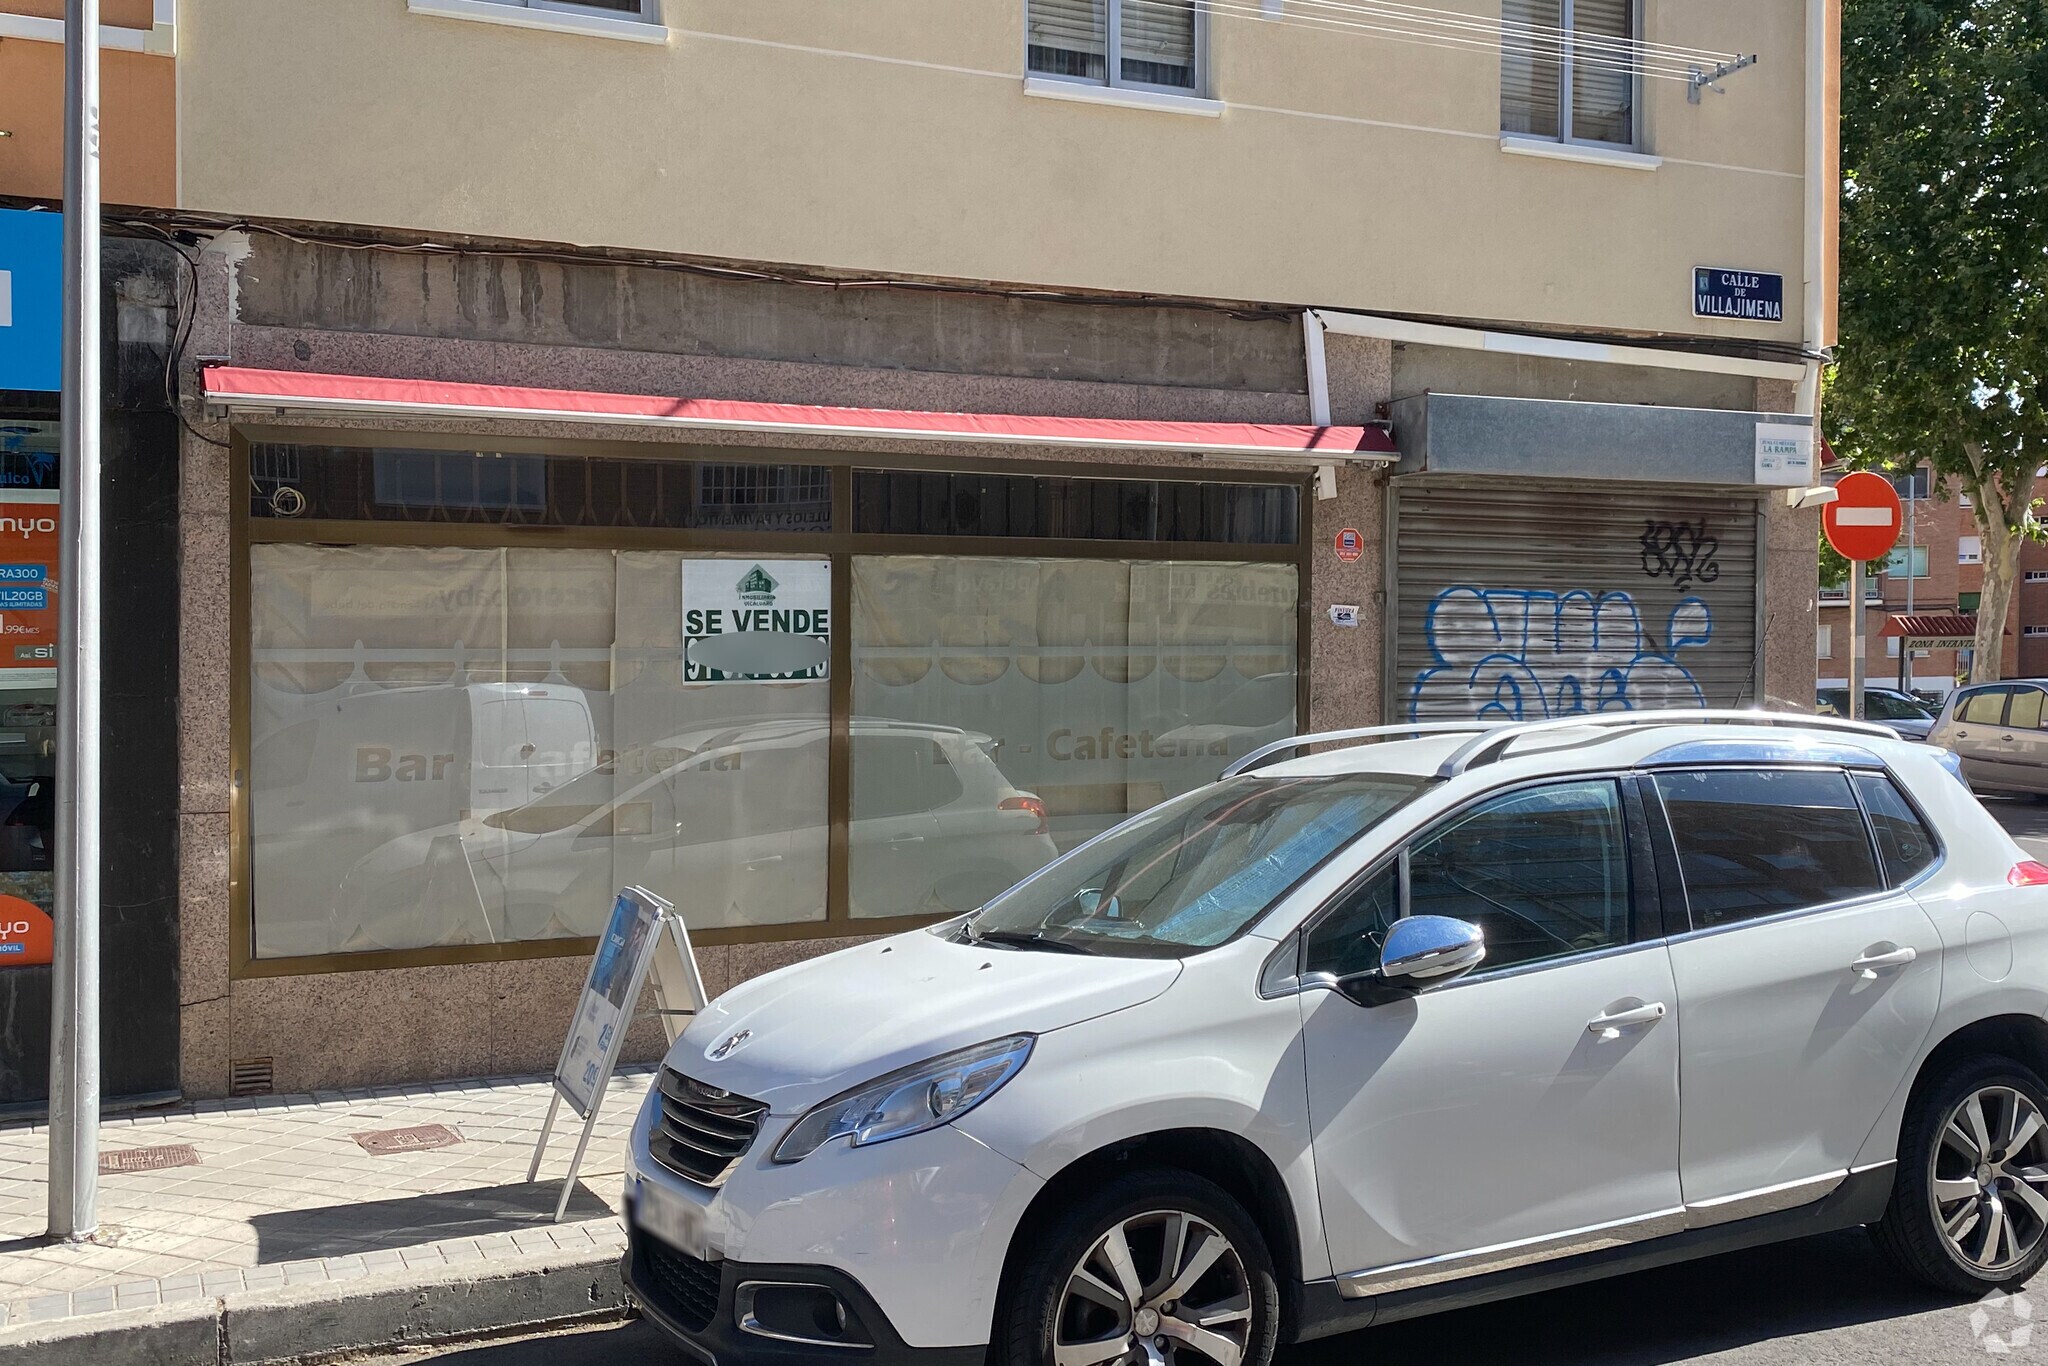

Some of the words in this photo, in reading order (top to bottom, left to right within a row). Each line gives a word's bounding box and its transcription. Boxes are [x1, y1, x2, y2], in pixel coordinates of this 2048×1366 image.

[1721, 272, 1760, 288] CALLE
[1734, 288, 1747, 297] DE
[1698, 294, 1781, 319] VILLAJIMENA
[0, 591, 44, 601] IL20GB
[685, 609, 722, 635] SE
[732, 609, 829, 634] VENDE
[1909, 640, 1934, 648] ZONA
[355, 747, 454, 783] Bar
[0, 944, 21, 952] ÓVIL
